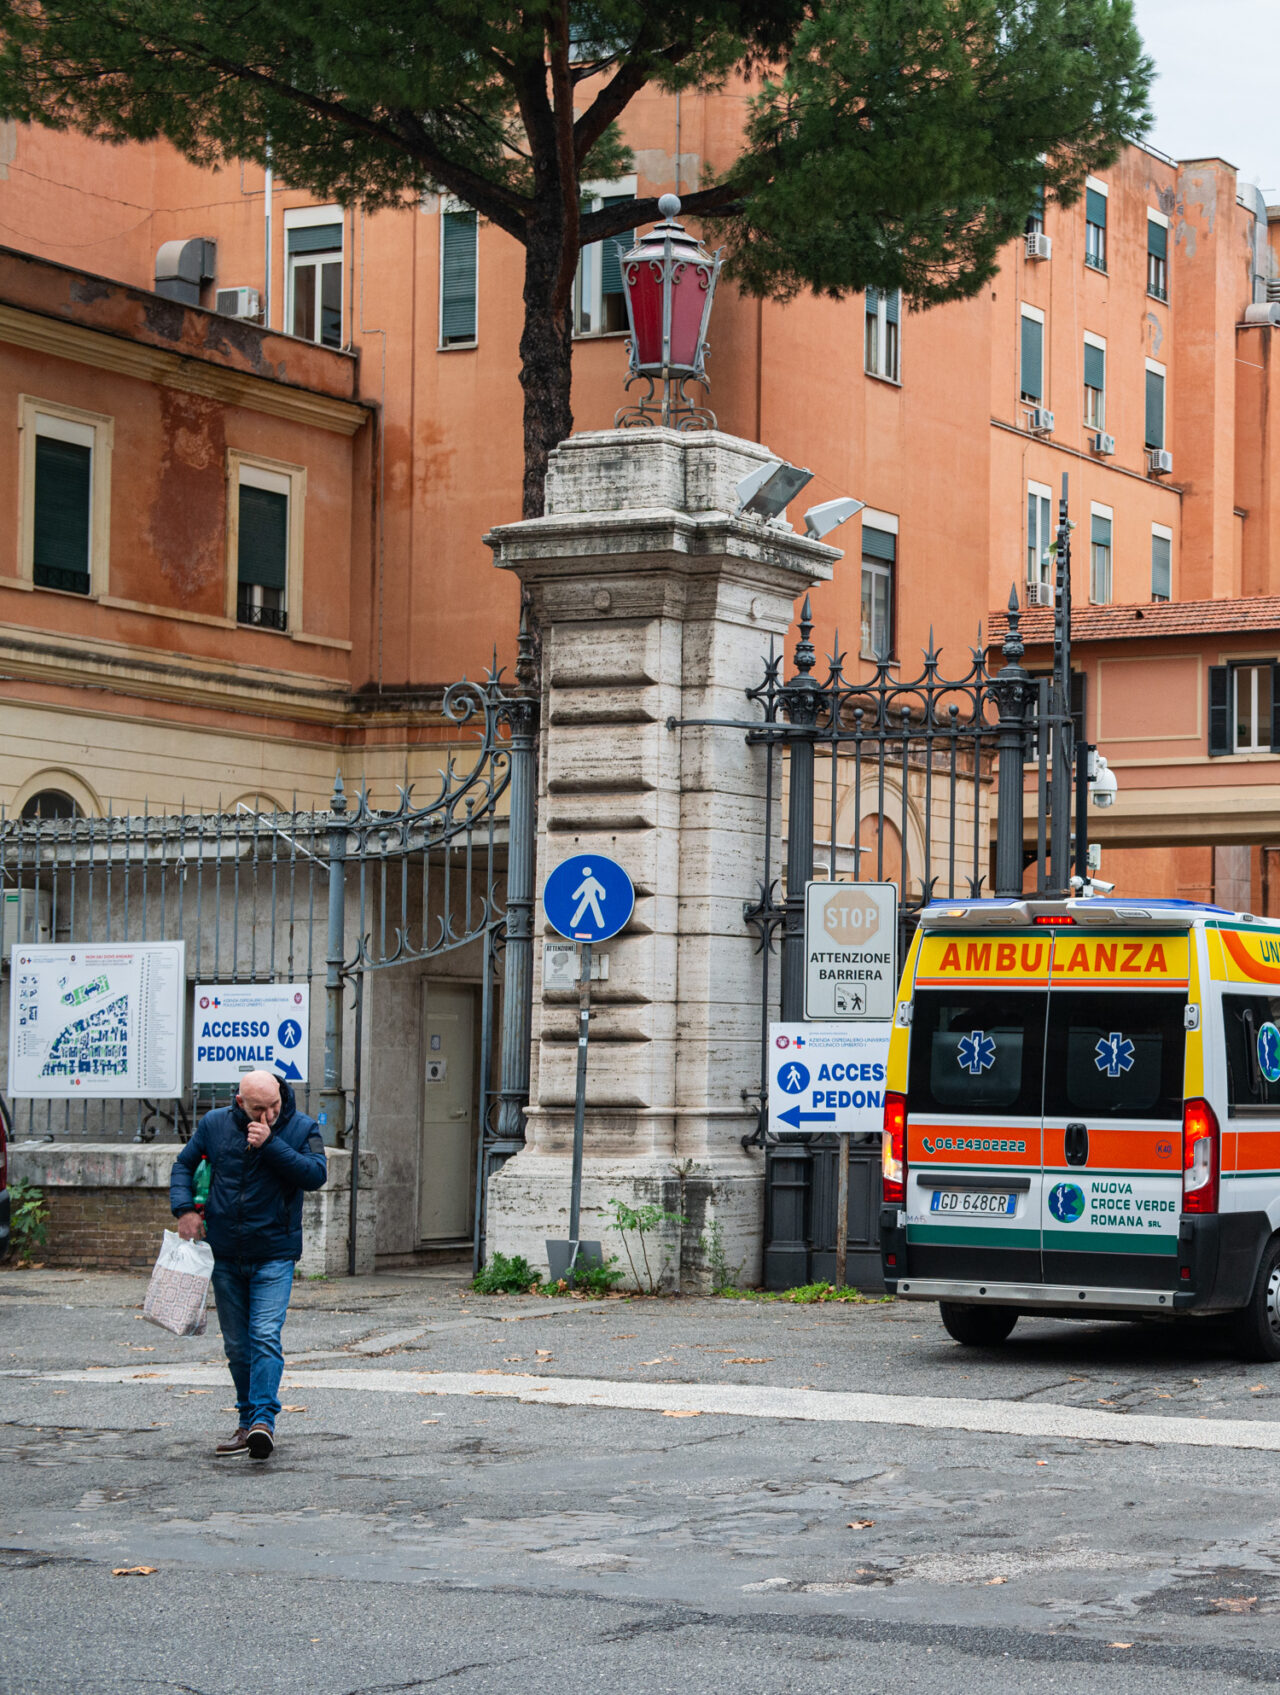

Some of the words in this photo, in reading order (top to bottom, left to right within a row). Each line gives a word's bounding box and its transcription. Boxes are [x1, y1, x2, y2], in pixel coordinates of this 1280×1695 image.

[826, 907, 878, 929] STOP
[810, 952, 891, 964] ATTENZIONE
[939, 942, 1168, 973] AMBULANZA
[819, 969, 883, 981] BARRIERA
[202, 1021, 270, 1037] ACCESSO
[197, 1045, 274, 1062] PEDONALE
[817, 1063, 887, 1081] ACCES
[935, 1138, 1026, 1152] 06.24302222
[1092, 1182, 1132, 1195] NUOVA
[940, 1193, 959, 1210] GD
[962, 1194, 1007, 1213] 648CR
[1091, 1198, 1131, 1211] CROCE
[1135, 1200, 1176, 1213] VERDE
[1091, 1214, 1143, 1228] ROMANA
[1148, 1220, 1162, 1228] SRL
